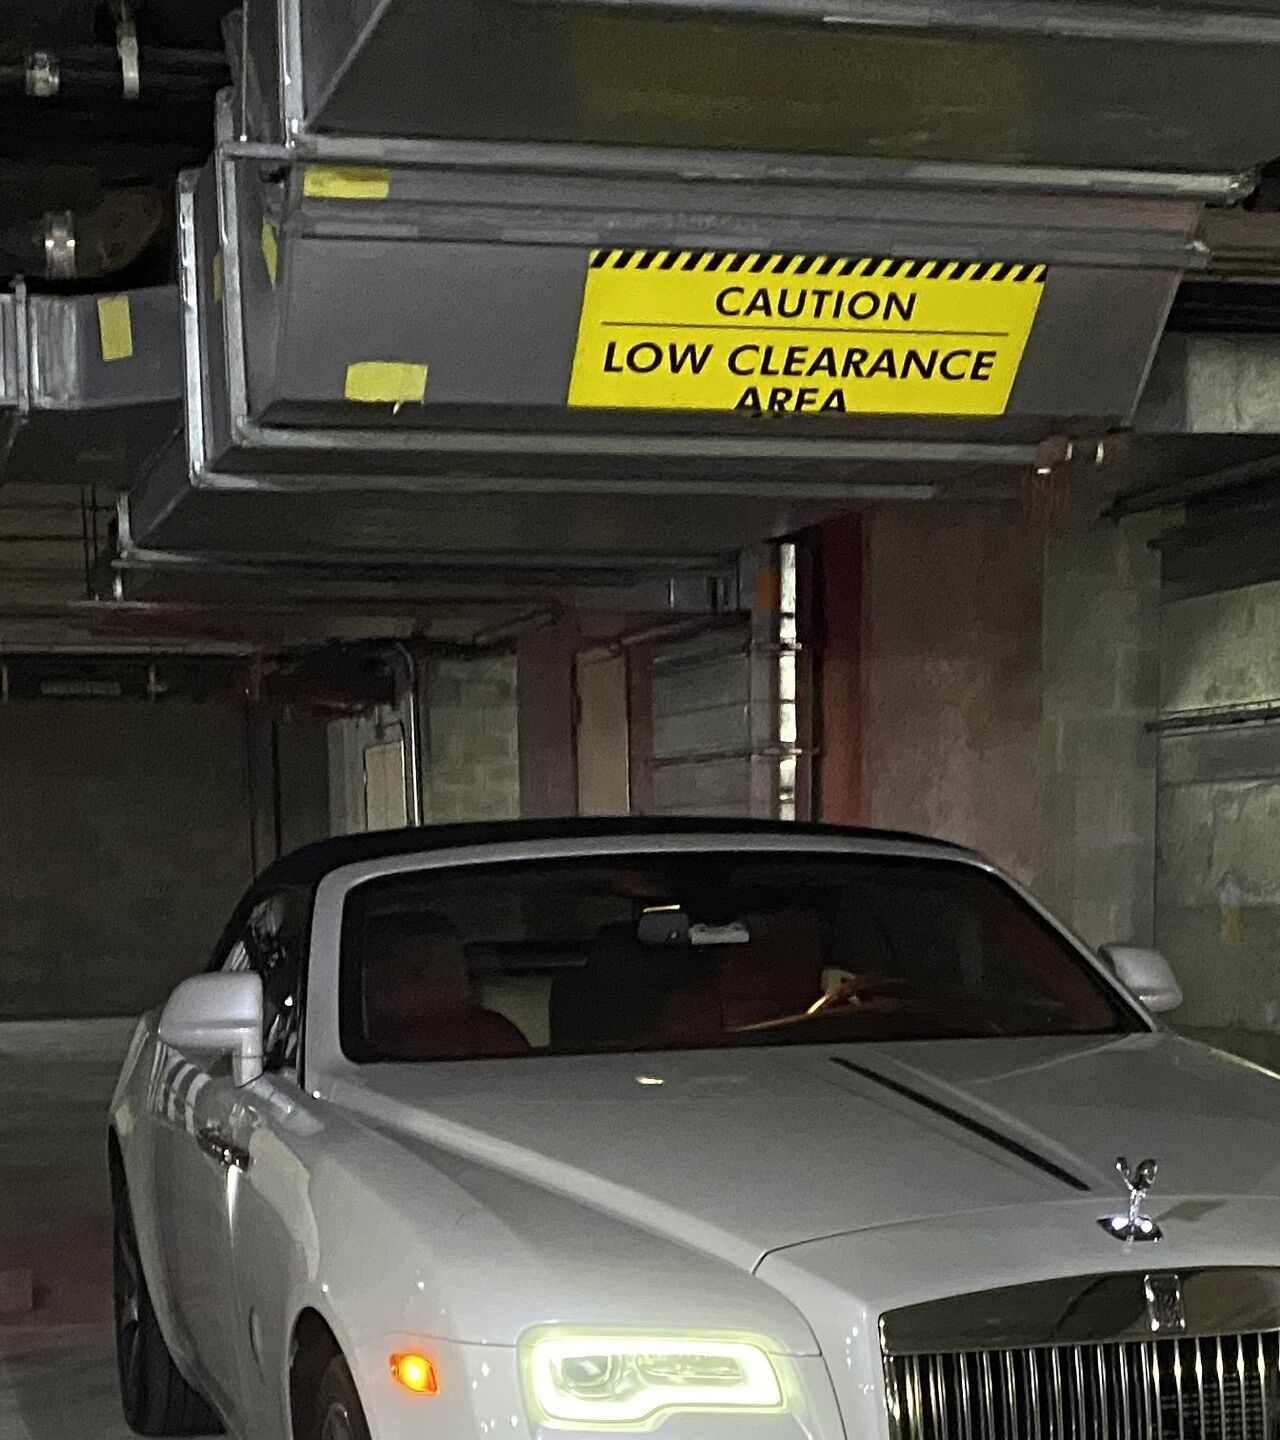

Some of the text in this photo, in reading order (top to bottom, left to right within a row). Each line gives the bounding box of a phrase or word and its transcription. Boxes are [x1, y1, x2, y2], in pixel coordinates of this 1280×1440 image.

[715, 287, 917, 321] CAUTION
[603, 341, 996, 381] LOW CLEARANCE
[734, 387, 847, 414] AREA
